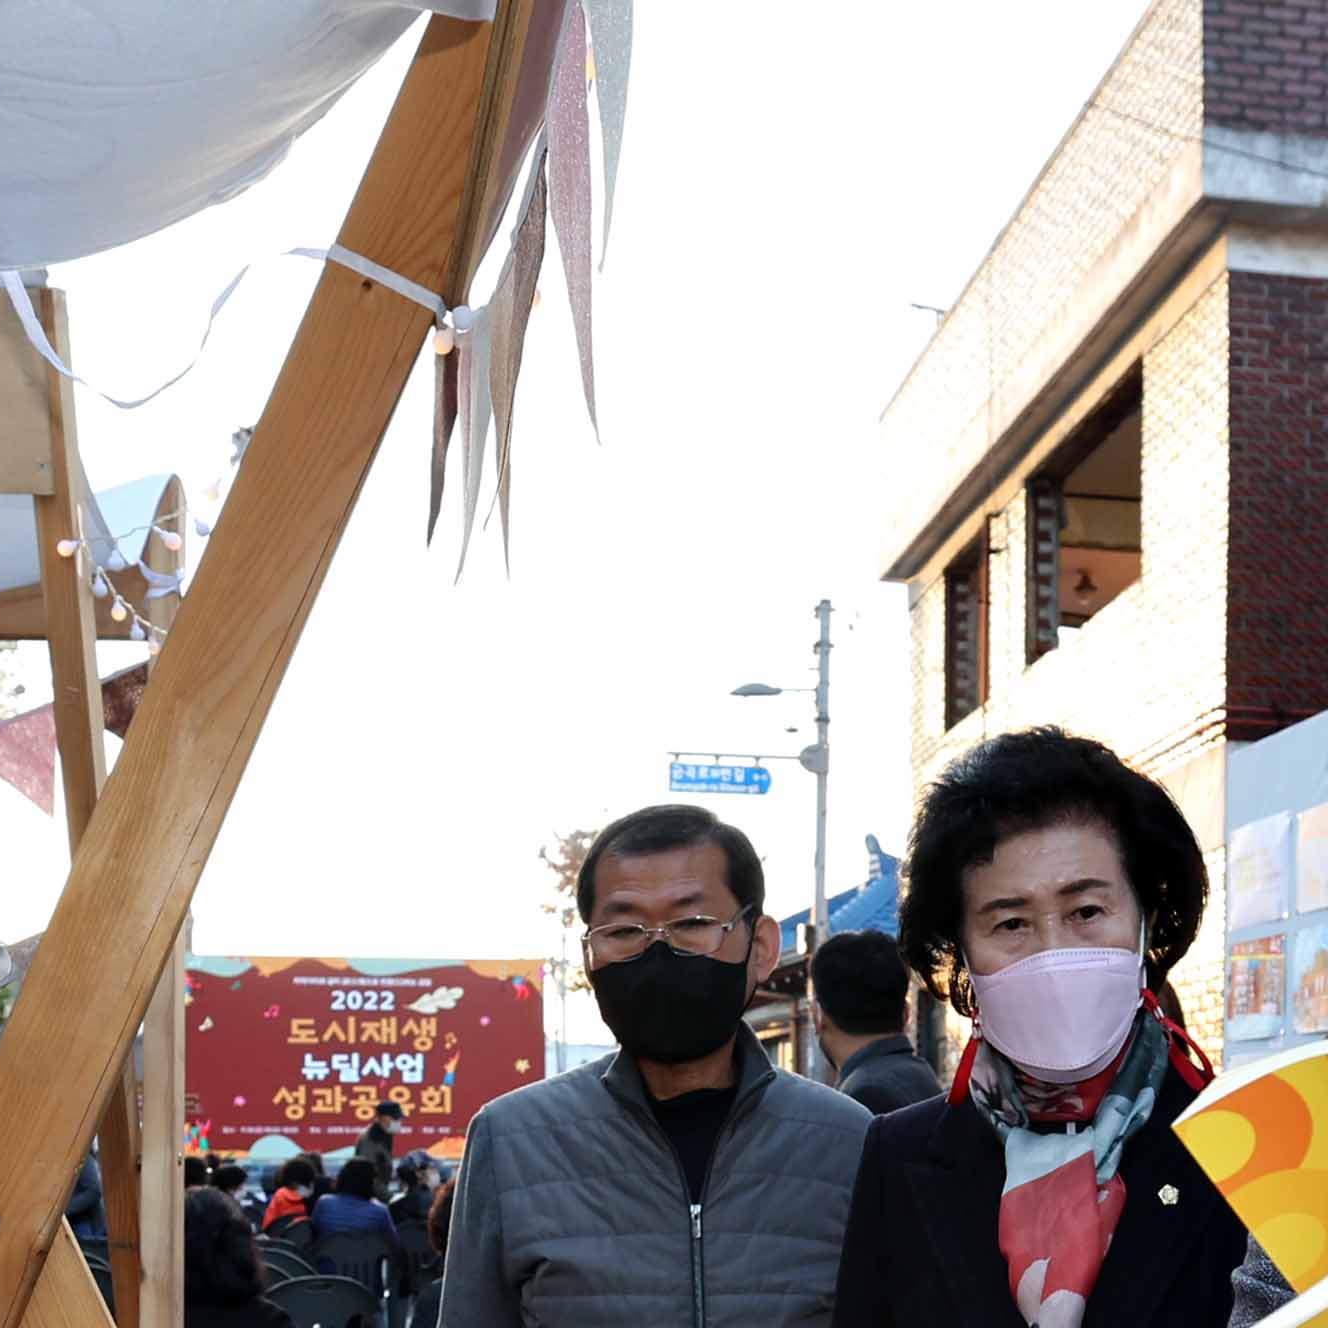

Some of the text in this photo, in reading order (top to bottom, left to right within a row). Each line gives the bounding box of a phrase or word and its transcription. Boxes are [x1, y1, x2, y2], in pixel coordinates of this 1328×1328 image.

[330, 989, 396, 1011] 2022
[286, 1016, 438, 1052] 도시재생
[301, 1052, 425, 1084] 뉴딜사업
[272, 1084, 453, 1121] 성과공유회
